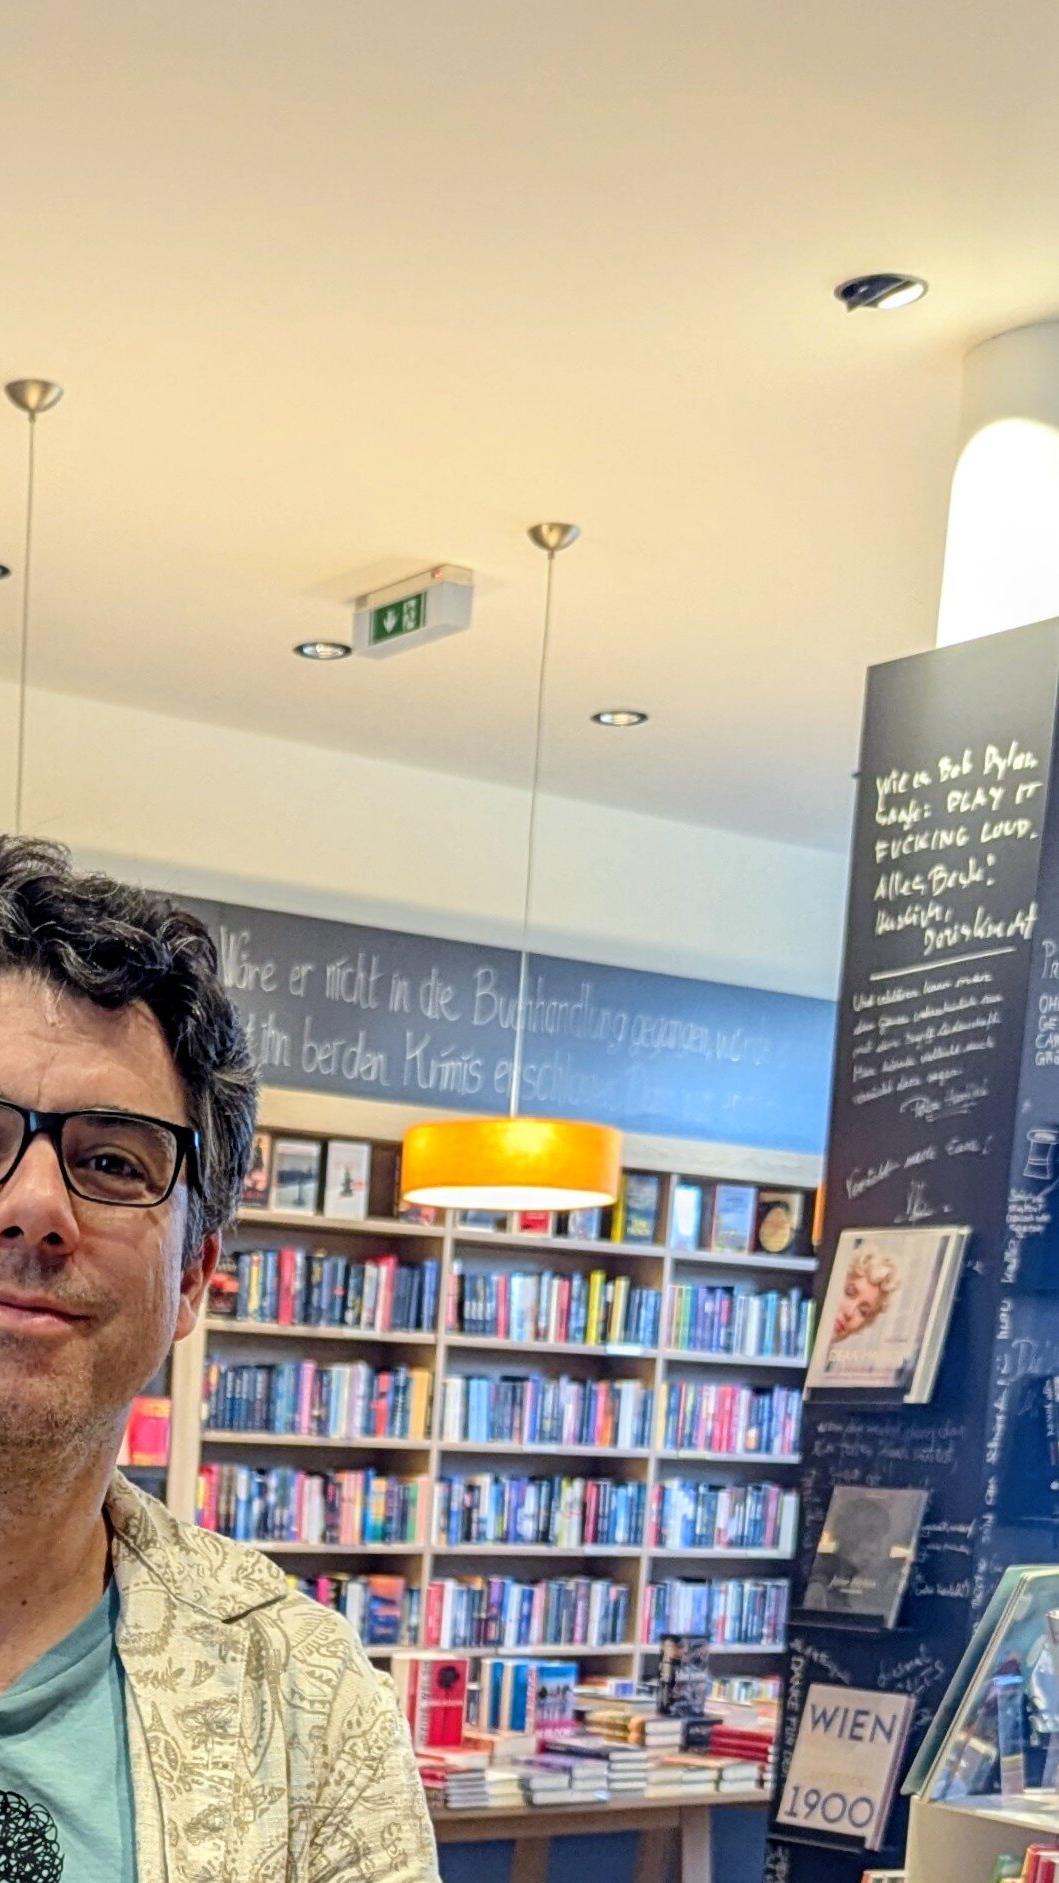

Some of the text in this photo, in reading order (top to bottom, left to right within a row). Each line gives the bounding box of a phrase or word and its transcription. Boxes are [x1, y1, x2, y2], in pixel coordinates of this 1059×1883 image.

[946, 786, 1006, 813] PLAY
[1014, 781, 1044, 805] IT
[875, 825, 970, 864] FUCKING
[289, 962, 315, 998] er
[325, 951, 385, 1010] nicht
[389, 972, 410, 1014] in
[419, 965, 462, 1022] die
[342, 1030, 392, 1087] den
[403, 1029, 483, 1096] Krimis
[810, 1703, 898, 1743] WIEN
[784, 1786, 875, 1828] 1900
